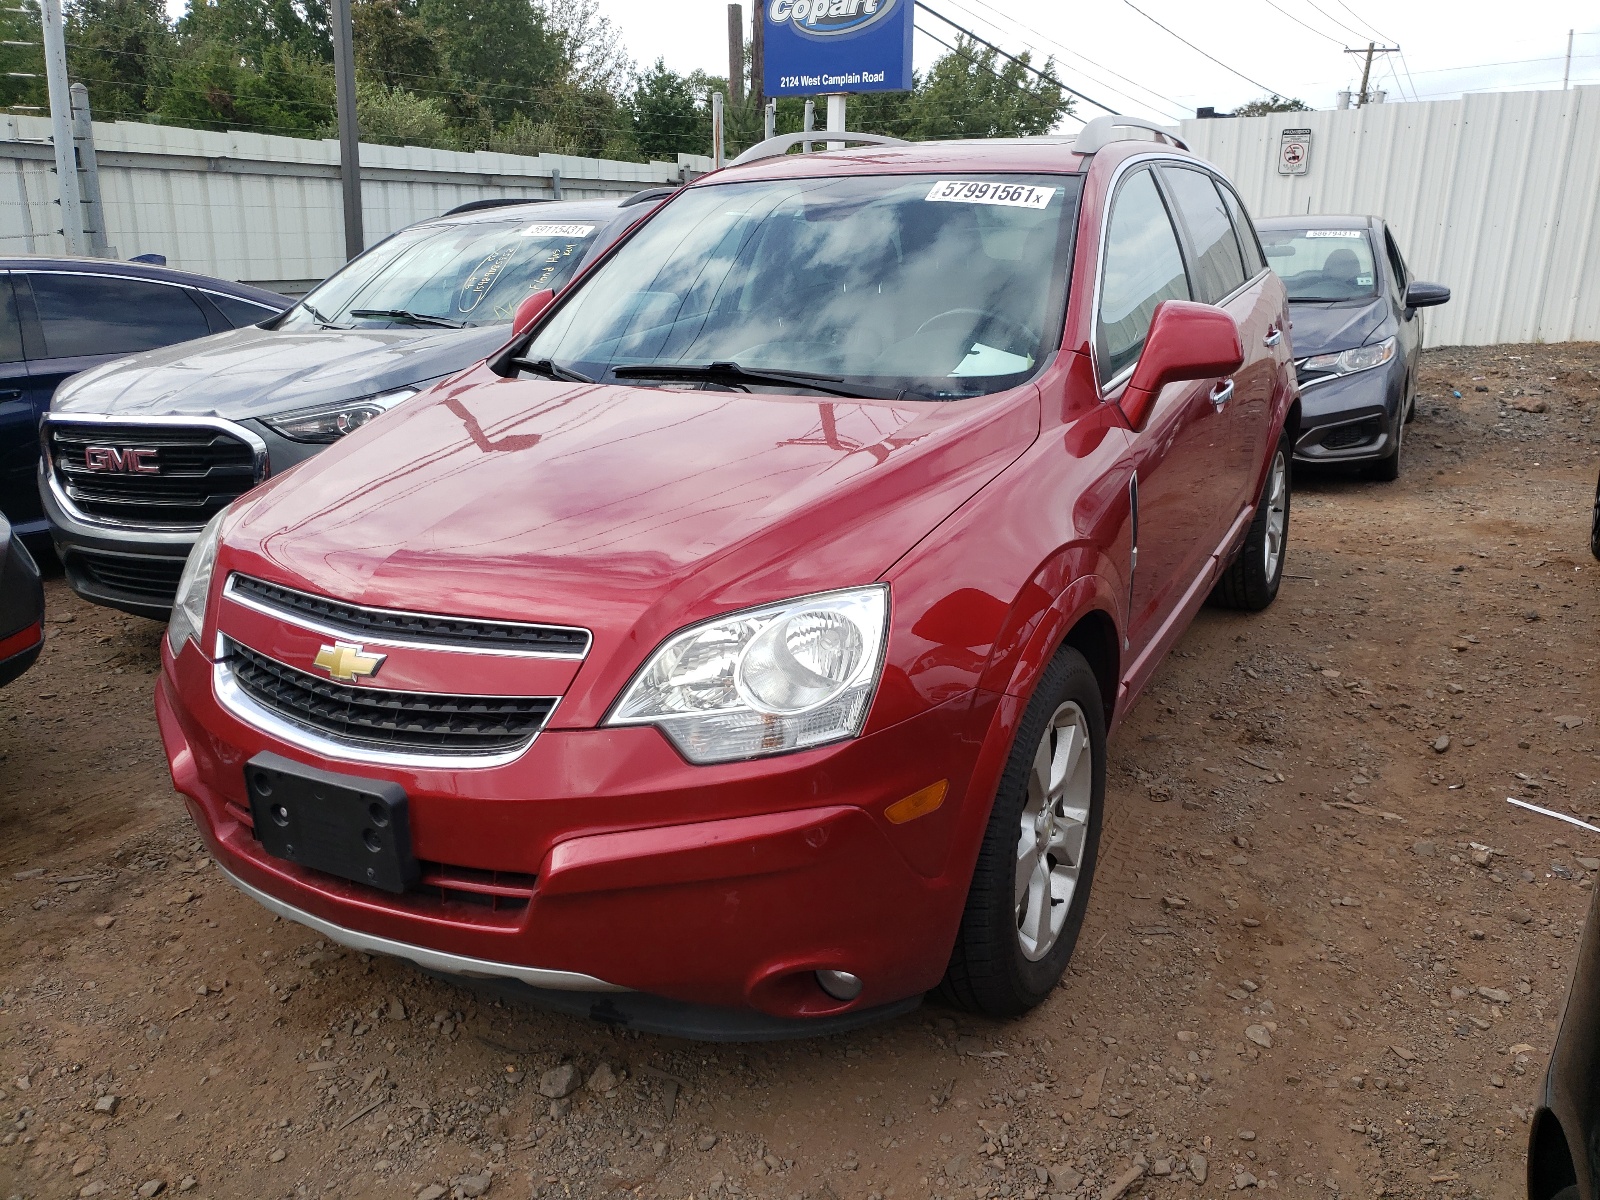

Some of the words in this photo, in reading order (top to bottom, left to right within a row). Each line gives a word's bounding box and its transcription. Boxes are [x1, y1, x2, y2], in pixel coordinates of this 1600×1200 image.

[770, 0, 878, 26] Copart
[780, 76, 800, 88] 2124
[800, 75, 821, 87] West
[822, 73, 861, 87] Camplain
[862, 71, 884, 83] Road
[85, 447, 160, 473] GMC
